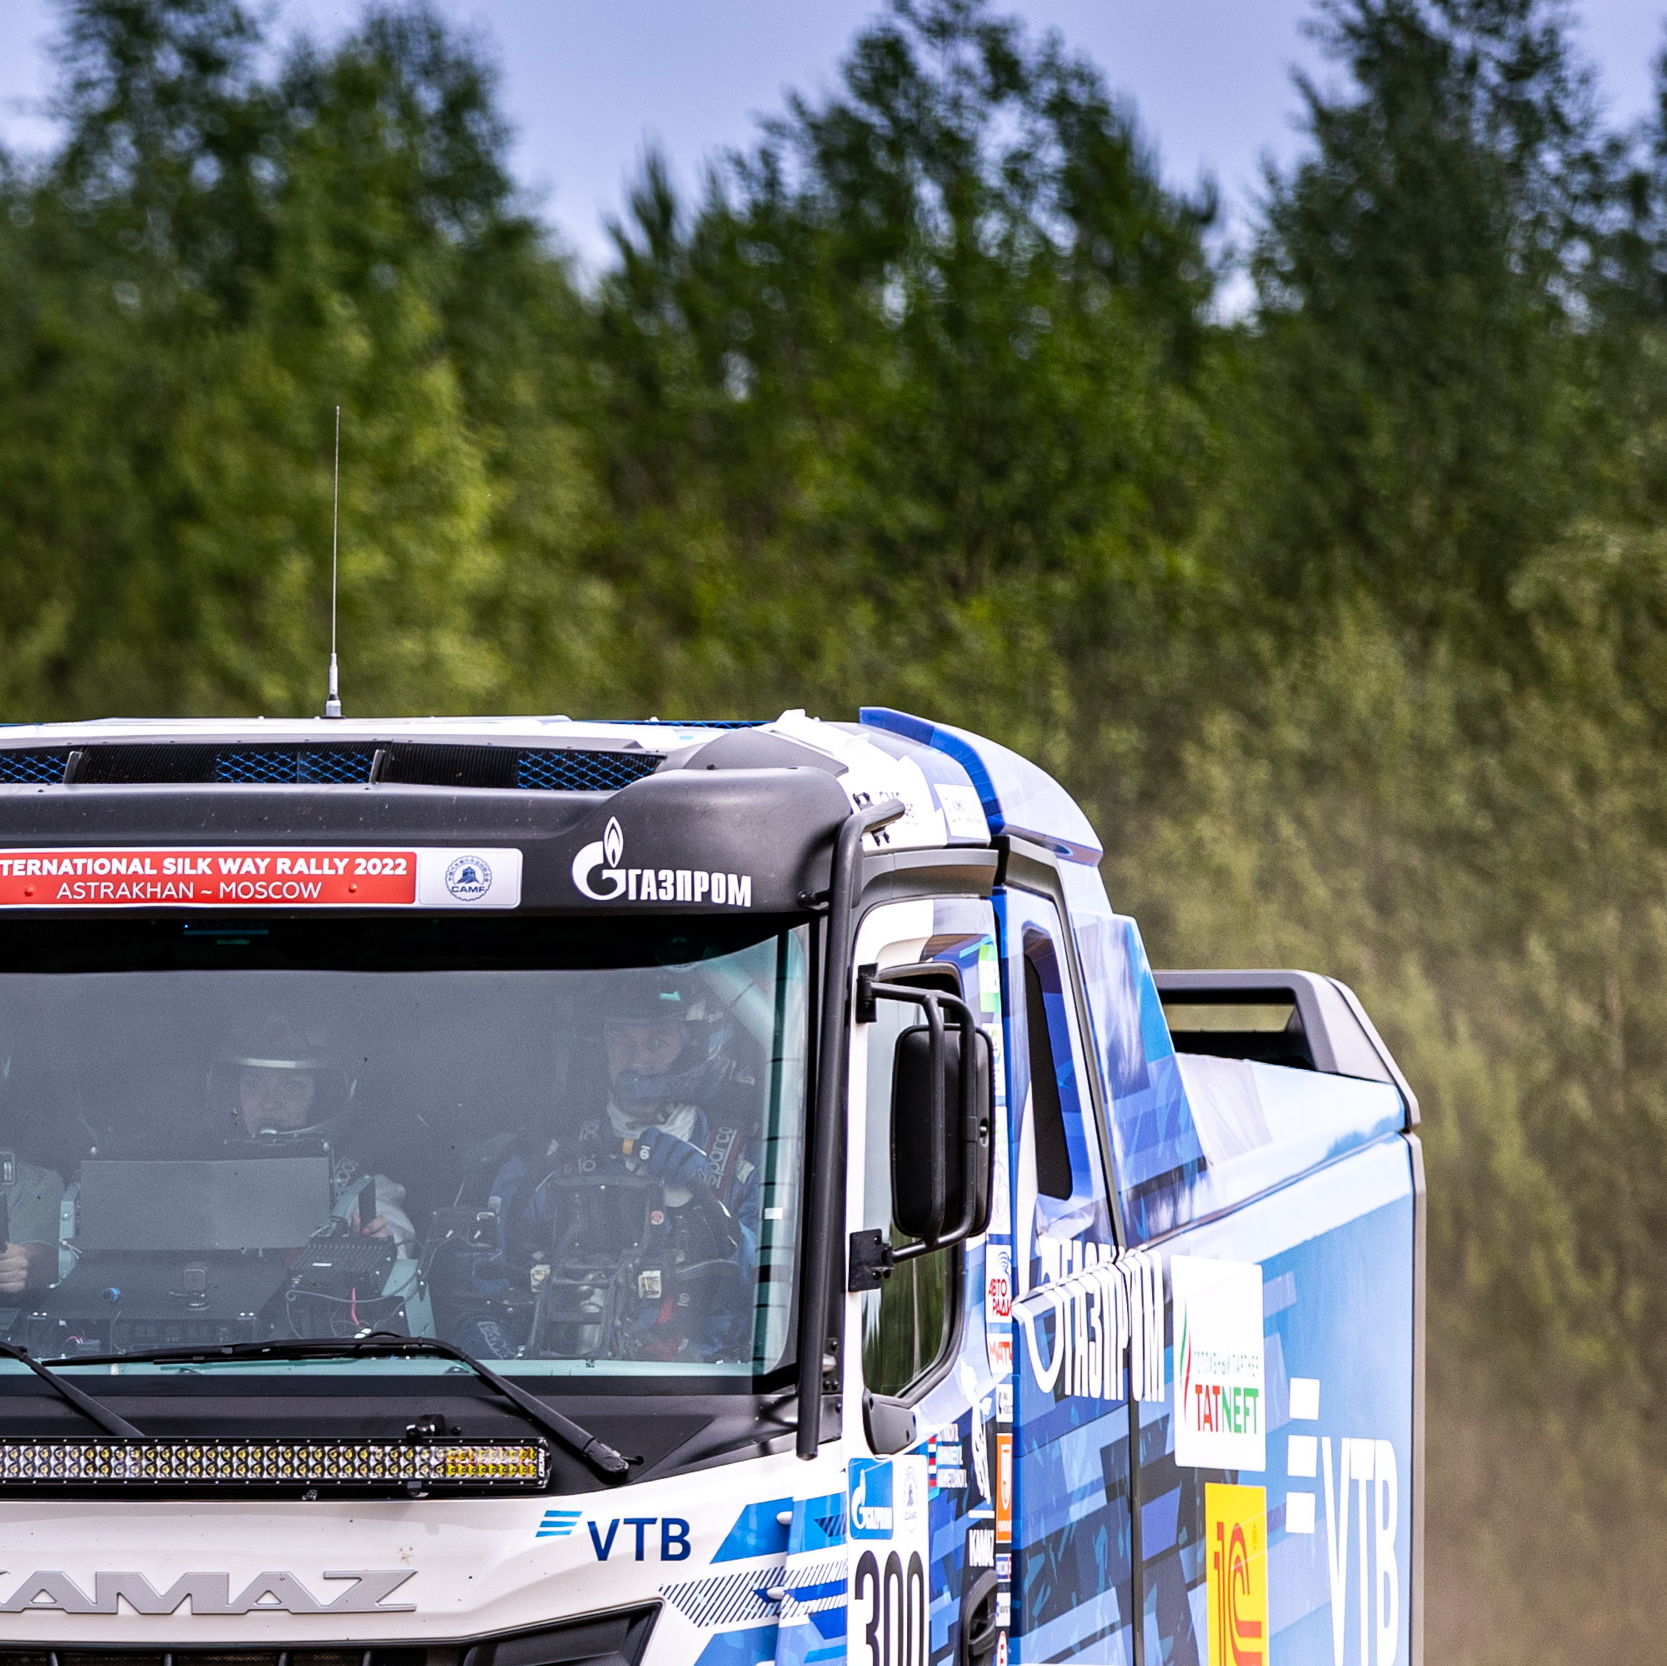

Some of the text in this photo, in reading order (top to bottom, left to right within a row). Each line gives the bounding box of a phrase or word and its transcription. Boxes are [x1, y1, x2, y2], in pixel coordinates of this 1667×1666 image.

[163, 857, 213, 877] SILK
[218, 857, 273, 877] WAY
[276, 857, 350, 877] RALLY
[353, 857, 408, 877] 2022
[56, 881, 195, 900] ASTRAKHAN
[218, 880, 323, 900] MOSCOW
[451, 885, 486, 893] CAMF
[627, 868, 753, 908] ГАЗПРОМ
[1194, 1383, 1259, 1435] TATNEFT
[587, 1517, 692, 1563] VTB
